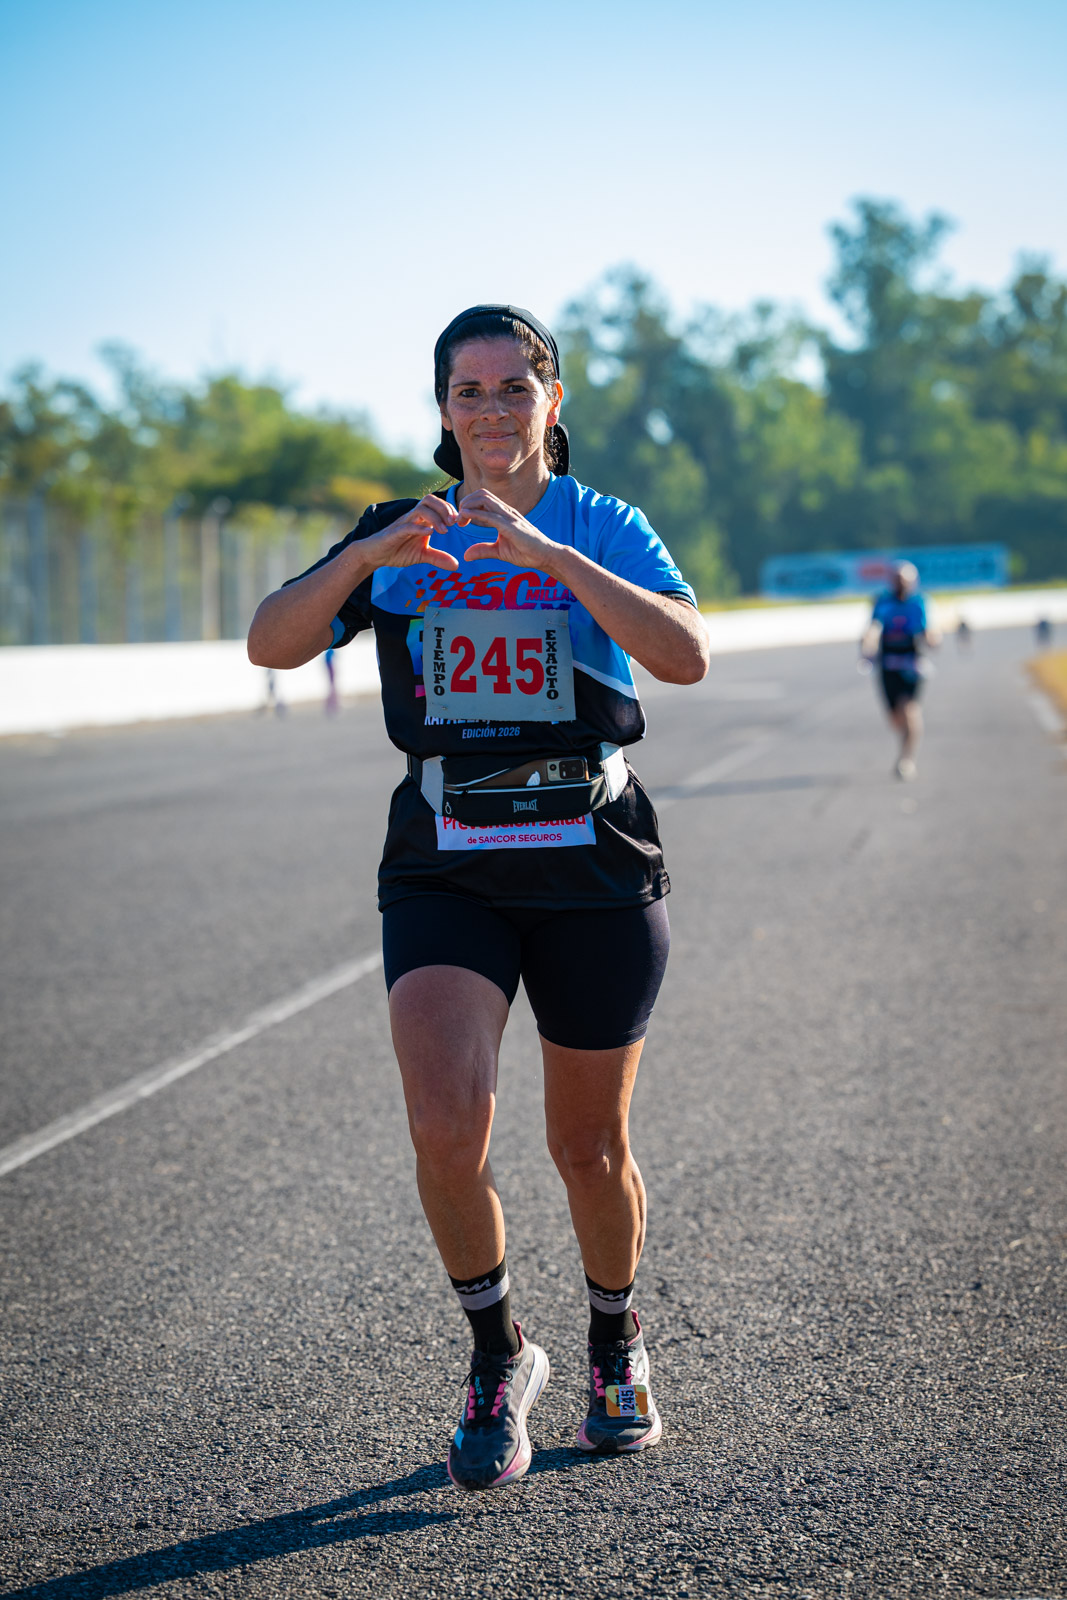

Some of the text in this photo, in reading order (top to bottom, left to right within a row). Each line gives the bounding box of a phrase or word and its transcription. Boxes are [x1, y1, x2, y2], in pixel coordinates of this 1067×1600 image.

[526, 589, 578, 602] MILLAS
[433, 627, 446, 696] TIEMPO
[450, 635, 545, 695] 245
[545, 630, 559, 700] EXACTO
[462, 726, 521, 739] EDICIÓN 2026
[512, 798, 539, 813] EVERLAST
[467, 833, 562, 844] de SANCOR SEGUROS
[621, 1390, 635, 1410] 245
